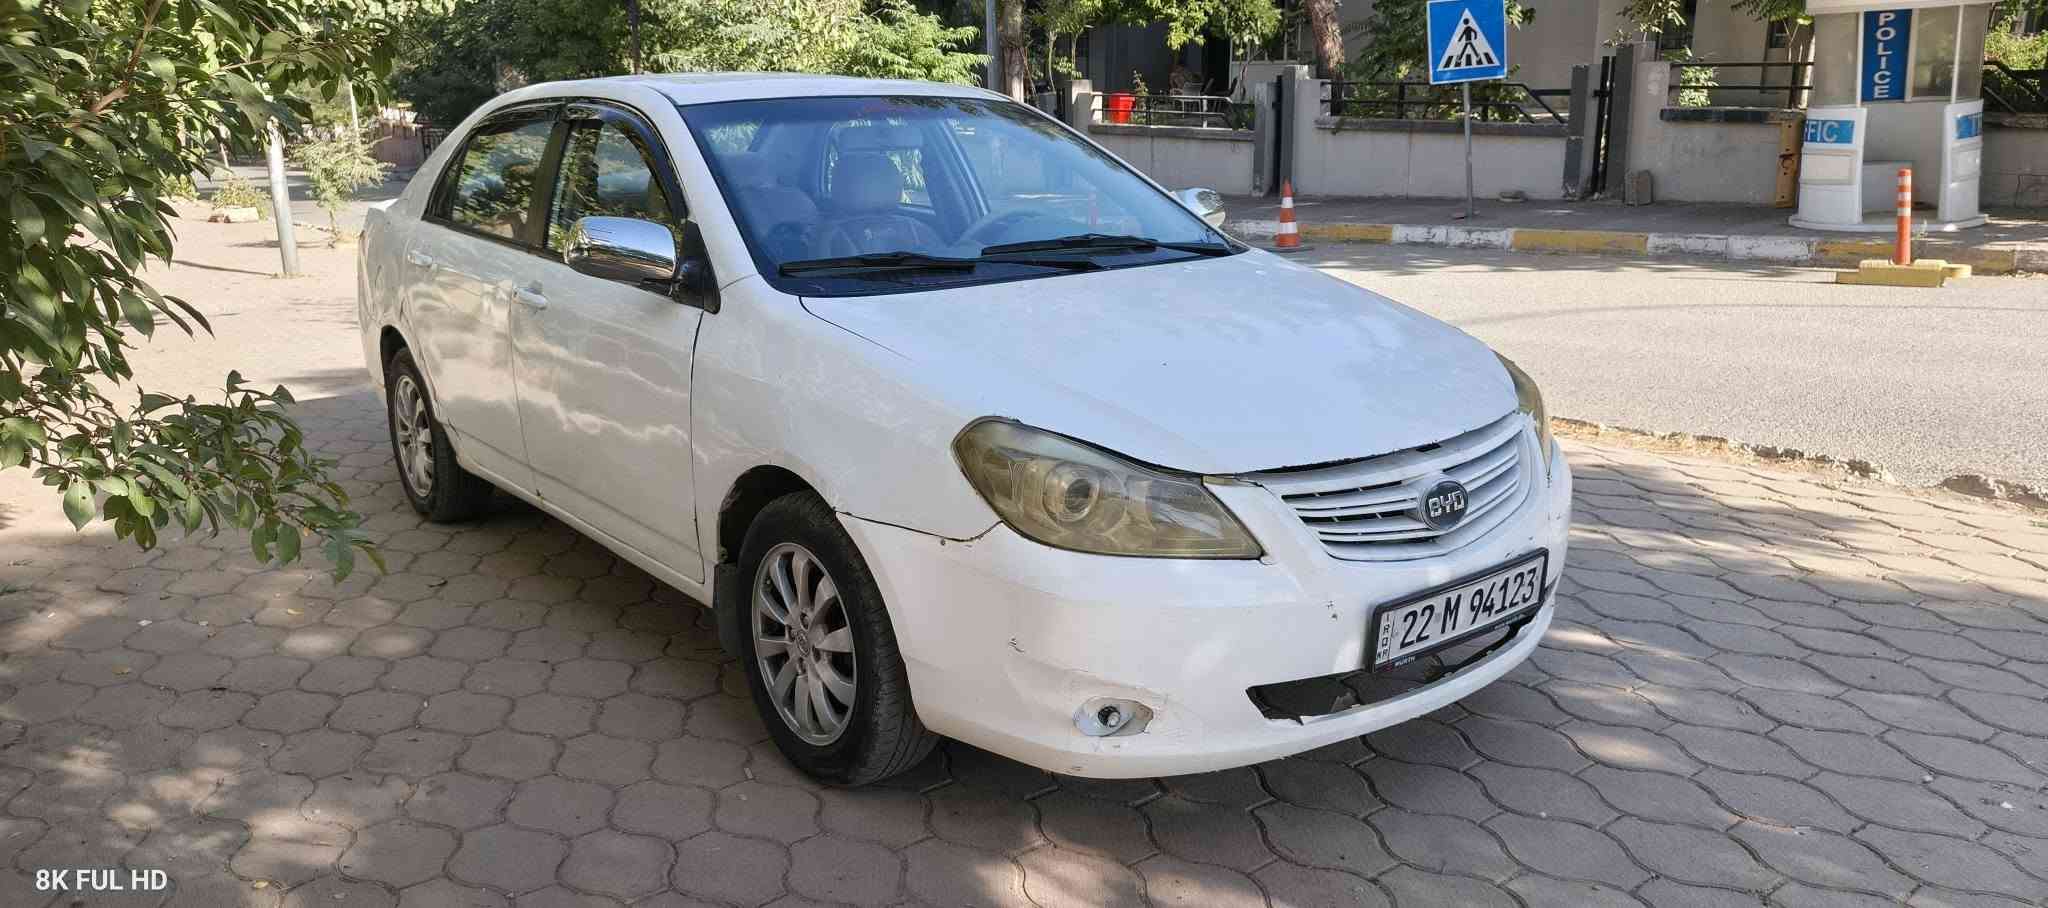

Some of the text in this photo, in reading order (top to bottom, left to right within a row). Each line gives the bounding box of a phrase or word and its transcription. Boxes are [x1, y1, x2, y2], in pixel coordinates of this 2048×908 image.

[1873, 12, 1897, 99] POLICE
[1804, 120, 1839, 142] FIC
[1428, 490, 1465, 518] BYD
[1400, 567, 1538, 650] 22 M 94123
